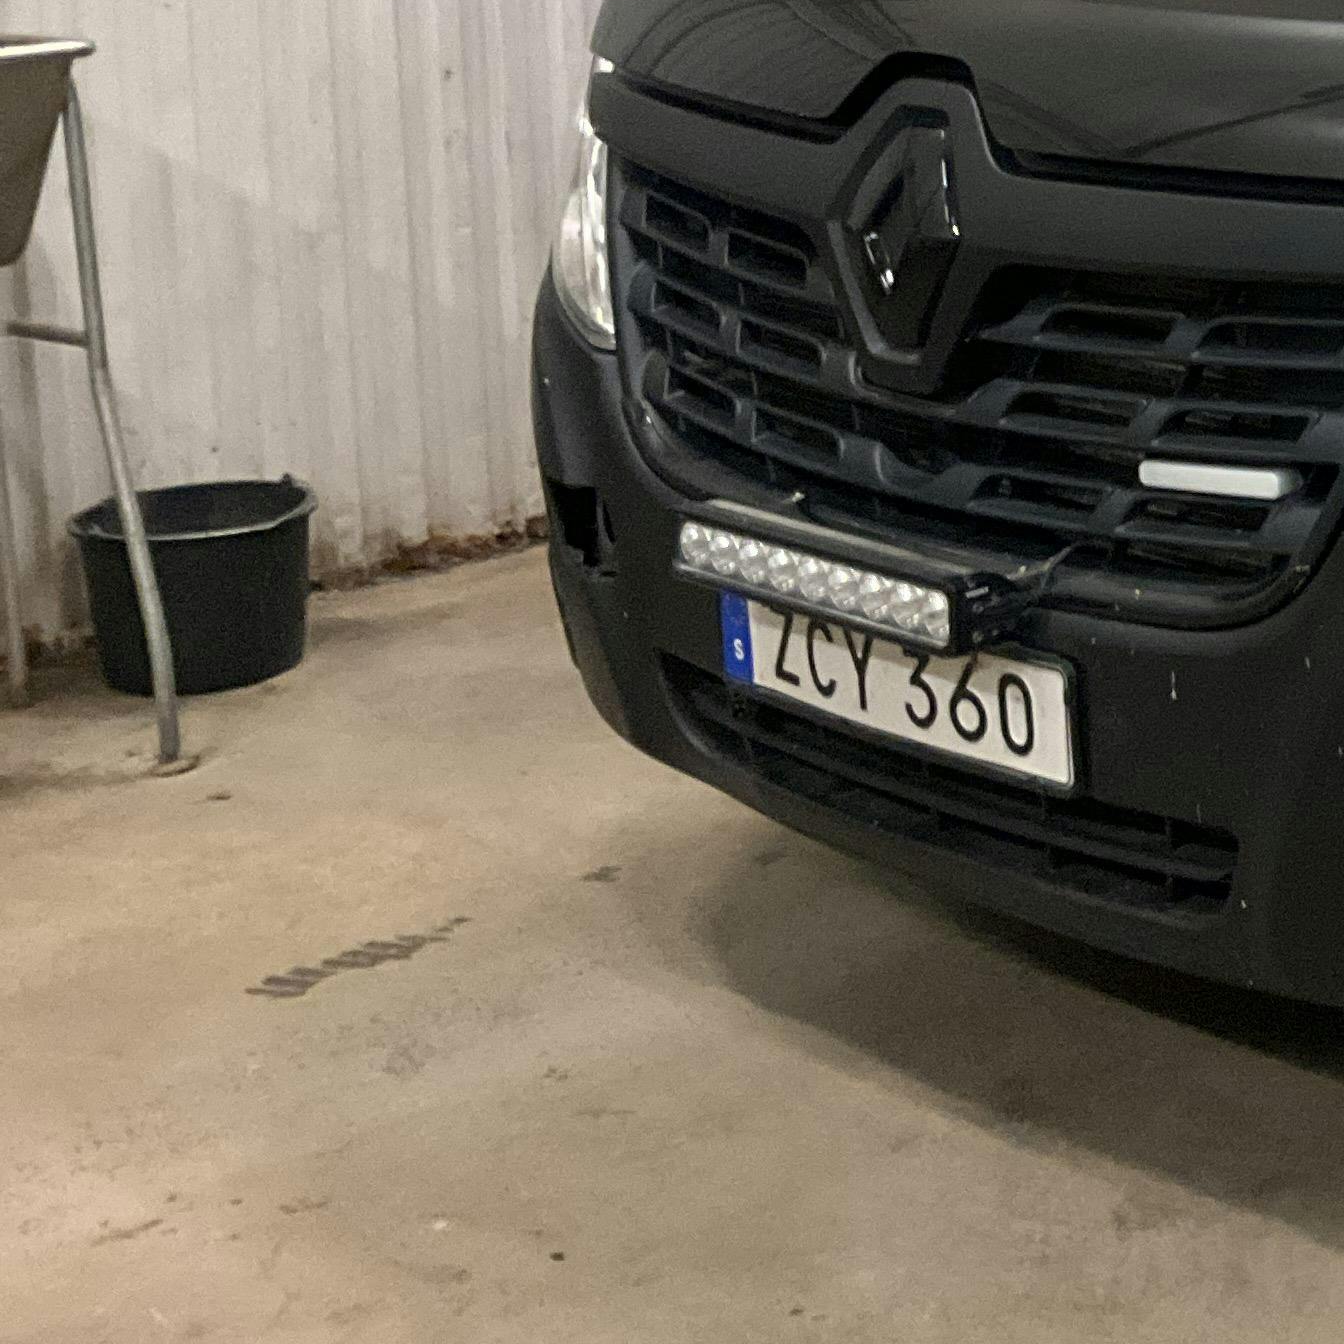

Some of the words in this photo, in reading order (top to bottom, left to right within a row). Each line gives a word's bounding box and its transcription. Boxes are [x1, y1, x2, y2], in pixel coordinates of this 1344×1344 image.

[733, 638, 745, 661] S
[765, 606, 874, 711] ZCY
[903, 649, 1034, 756] 360
